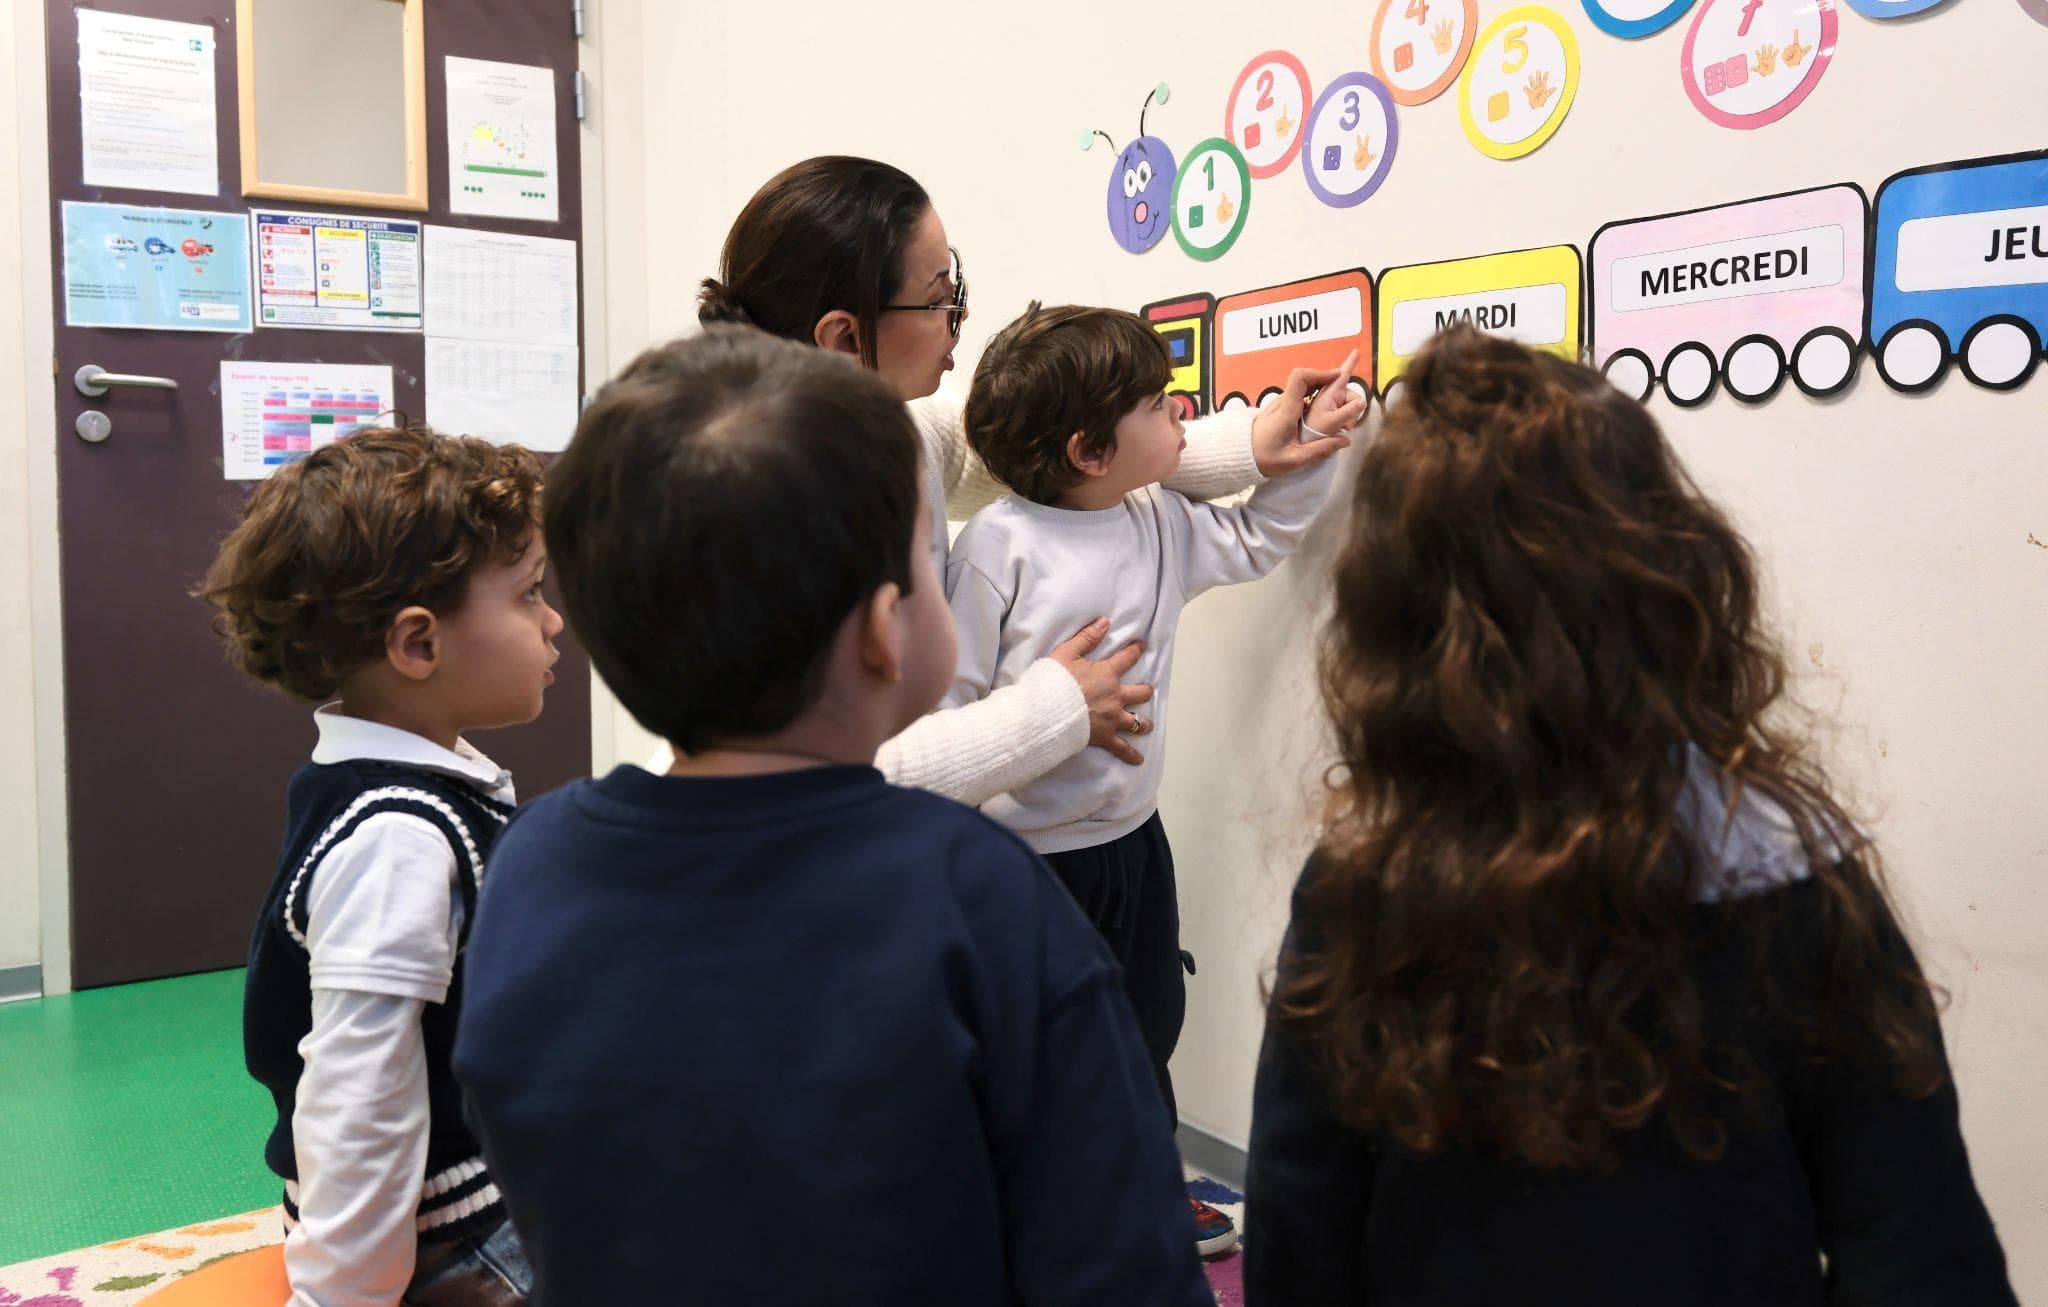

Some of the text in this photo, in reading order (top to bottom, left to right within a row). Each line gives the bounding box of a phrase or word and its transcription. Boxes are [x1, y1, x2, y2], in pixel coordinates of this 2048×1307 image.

[1501, 25, 1528, 74] 5
[1256, 69, 1274, 111] 2
[1338, 90, 1361, 132] 3
[1202, 156, 1214, 192] 1
[288, 215, 338, 228] CONSIGNES
[339, 220, 350, 228] DE
[1641, 246, 1808, 297] MERCREDI
[1259, 309, 1318, 338] LUNDI
[1435, 303, 1516, 332] MARDI
